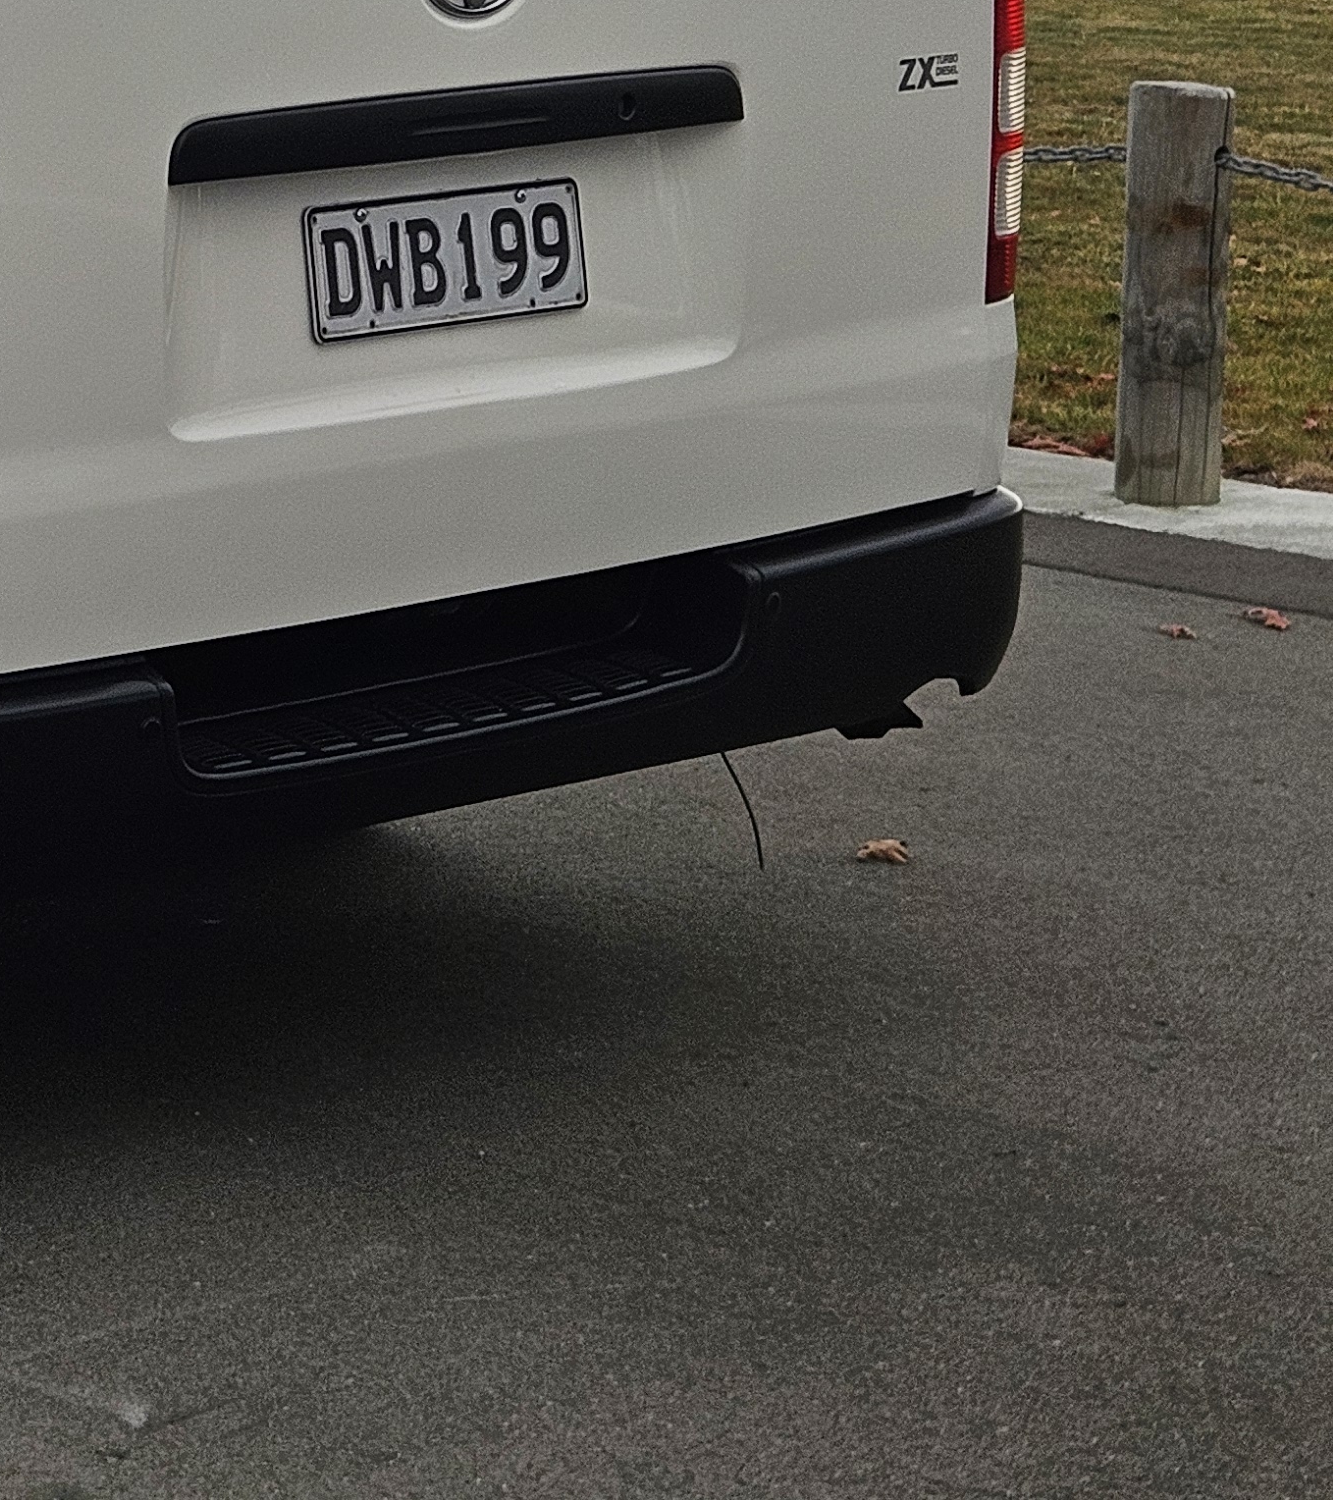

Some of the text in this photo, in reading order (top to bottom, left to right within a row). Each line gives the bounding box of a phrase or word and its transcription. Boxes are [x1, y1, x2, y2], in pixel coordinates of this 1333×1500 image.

[936, 53, 958, 64] TURBO
[898, 56, 938, 92] ZX
[936, 65, 958, 76] DIESEL
[320, 202, 571, 318] DWB199
